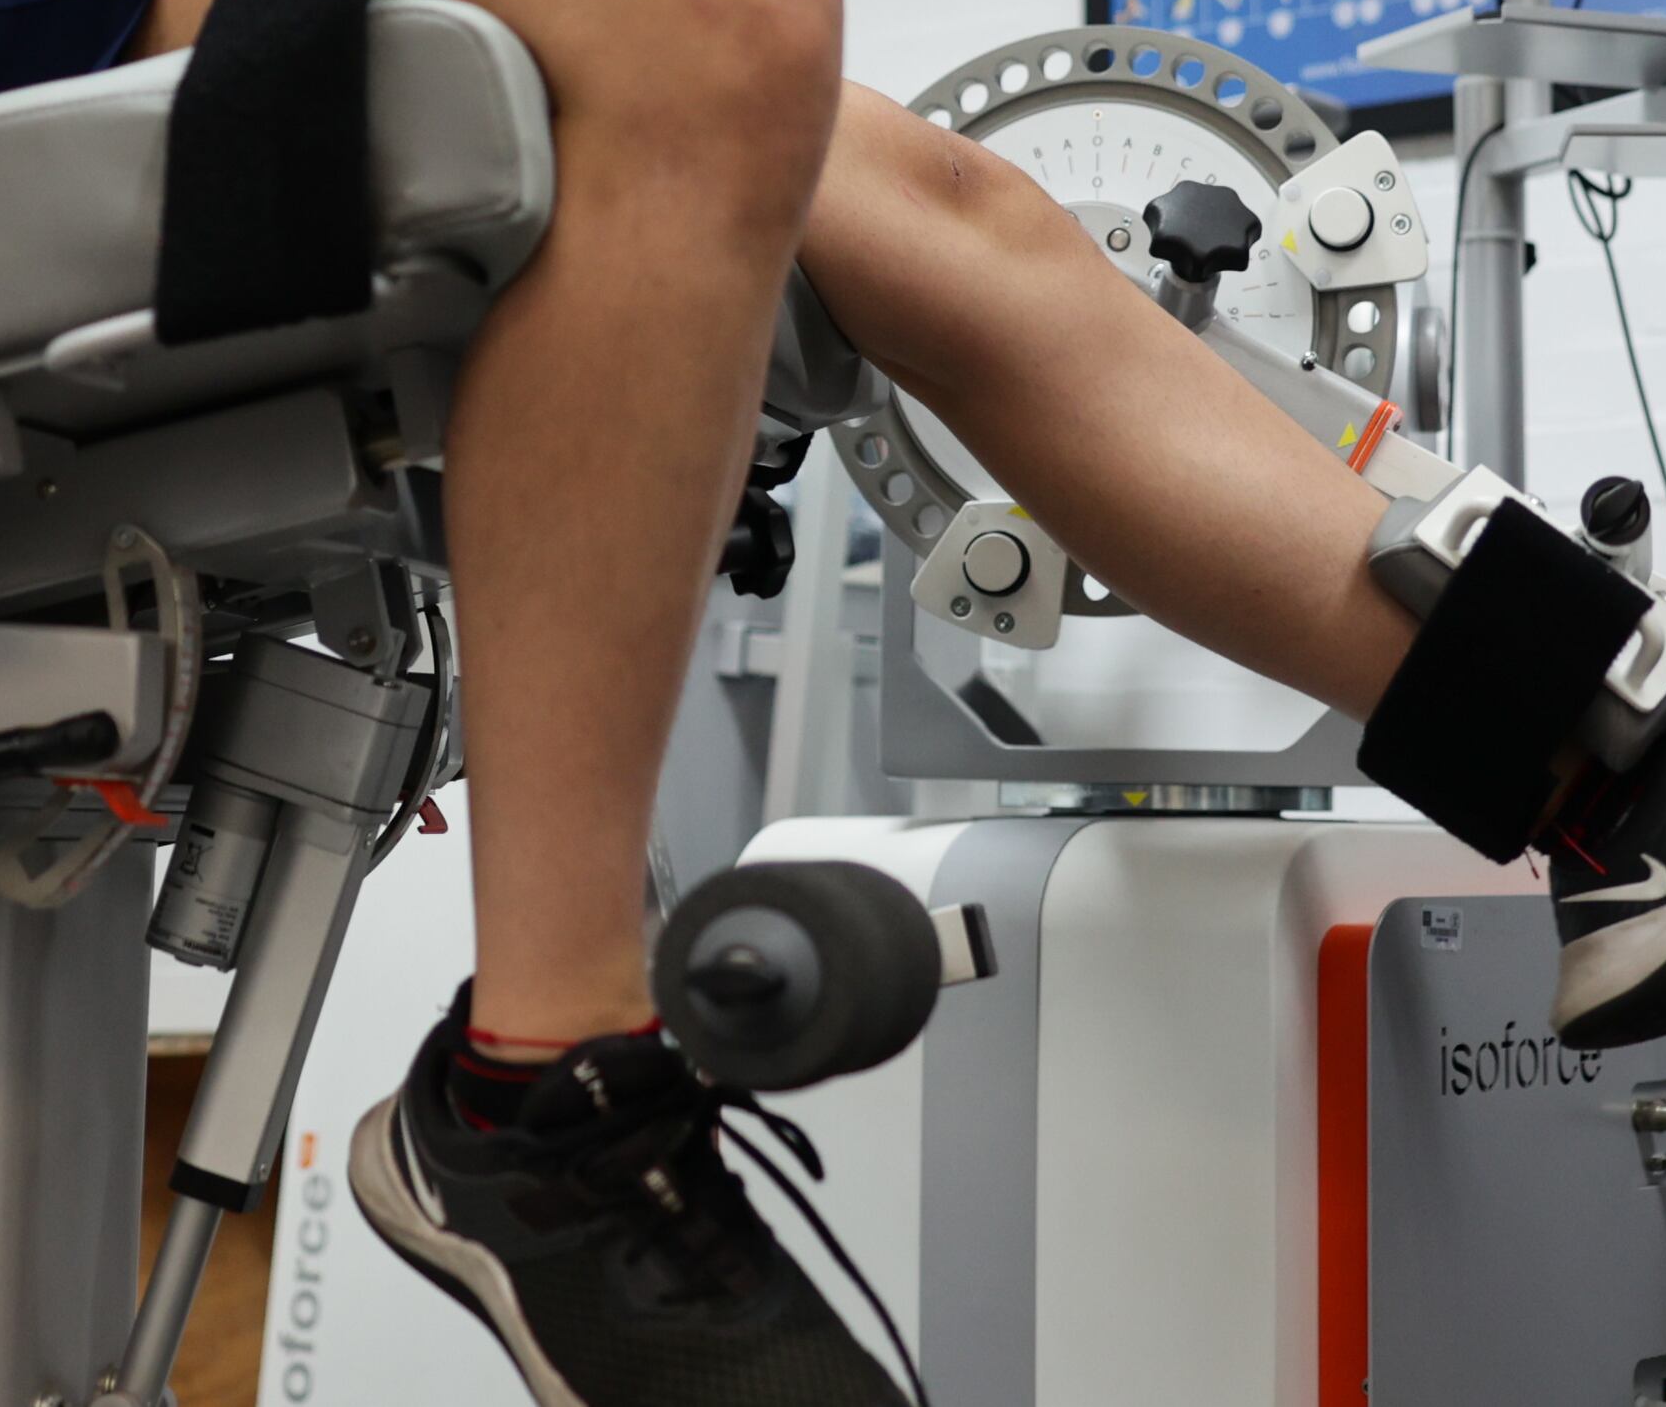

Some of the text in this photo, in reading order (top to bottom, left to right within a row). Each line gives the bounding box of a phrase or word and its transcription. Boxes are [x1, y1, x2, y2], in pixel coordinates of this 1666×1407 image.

[1063, 139, 1073, 151] A
[1123, 138, 1133, 149] A
[1153, 144, 1162, 156] B
[1181, 157, 1192, 169] C
[1440, 1021, 1601, 1095] isoforce
